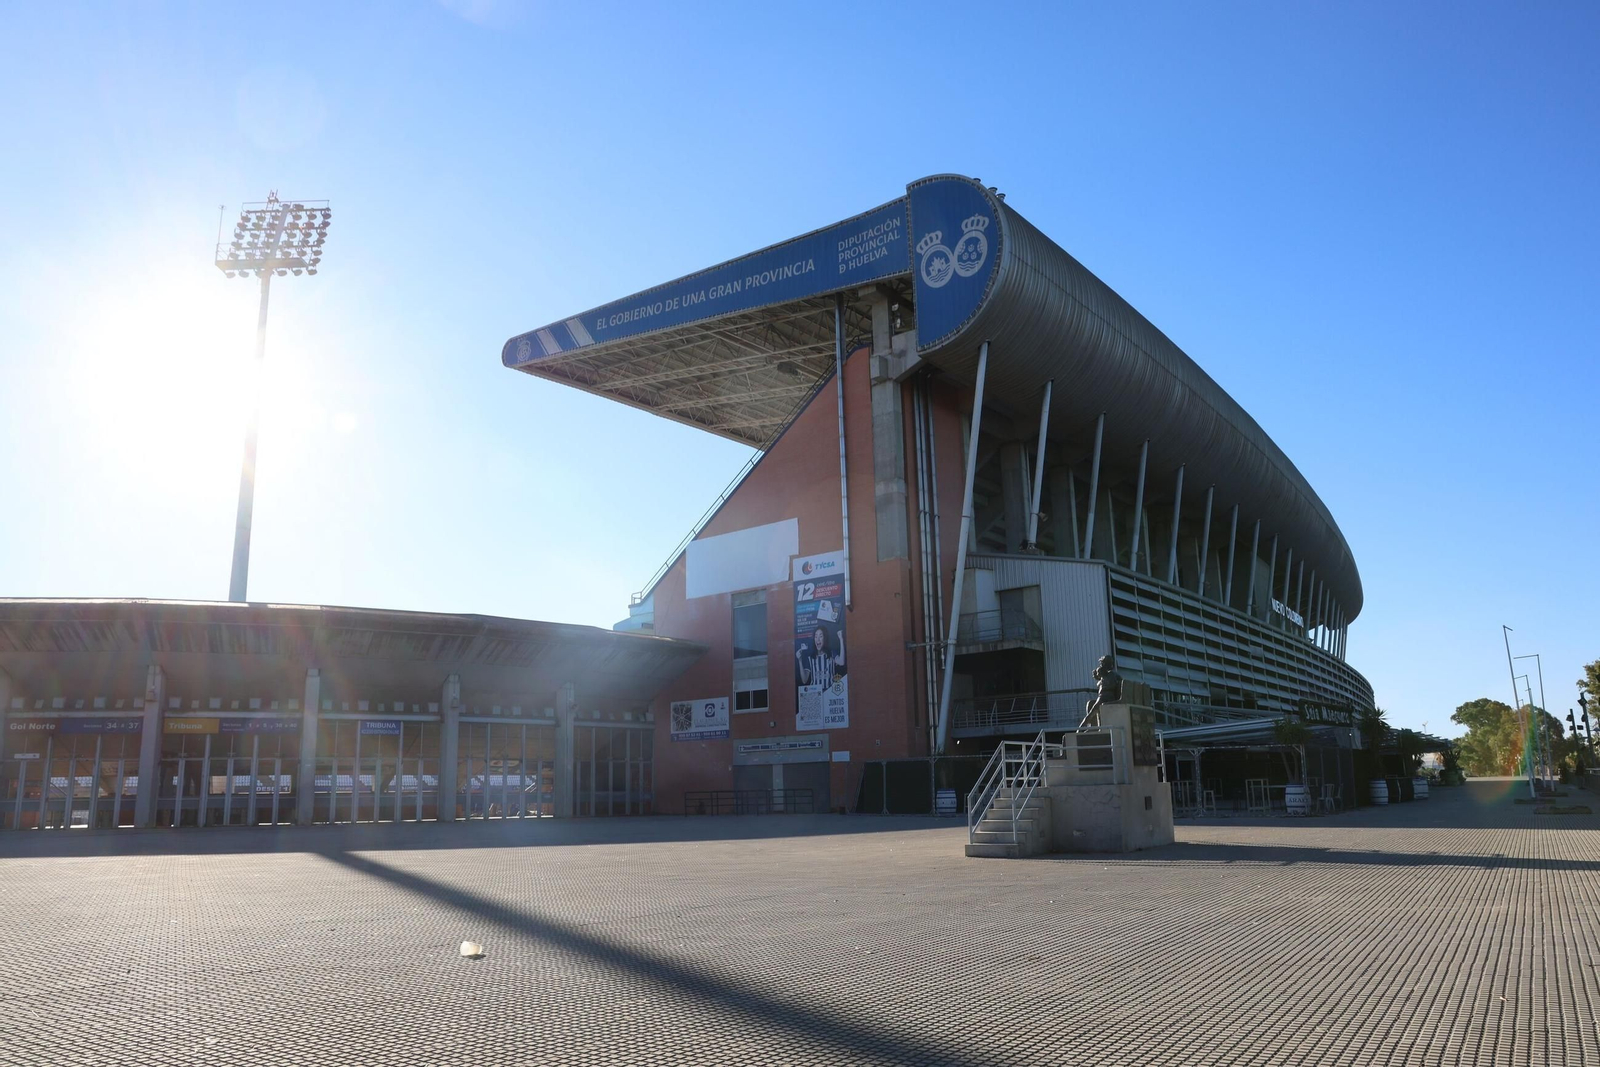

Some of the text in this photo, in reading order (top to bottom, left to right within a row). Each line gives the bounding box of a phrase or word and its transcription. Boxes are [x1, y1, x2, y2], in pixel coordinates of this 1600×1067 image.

[838, 216, 901, 252] DIPUTACIÓN
[838, 229, 901, 263] PROVINCIAL
[848, 246, 888, 270] HUELVA
[596, 258, 815, 330] EL GOBIERNO DE UNA GRAN PROVINCIA
[797, 582, 815, 602] 12
[828, 698, 845, 707] JUNTOS
[829, 706, 845, 715] HUELVA
[10, 722, 56, 730] Gol Norte
[168, 722, 203, 730] Tribuna
[825, 716, 831, 724] ES
[830, 715, 845, 723] MEJOR
